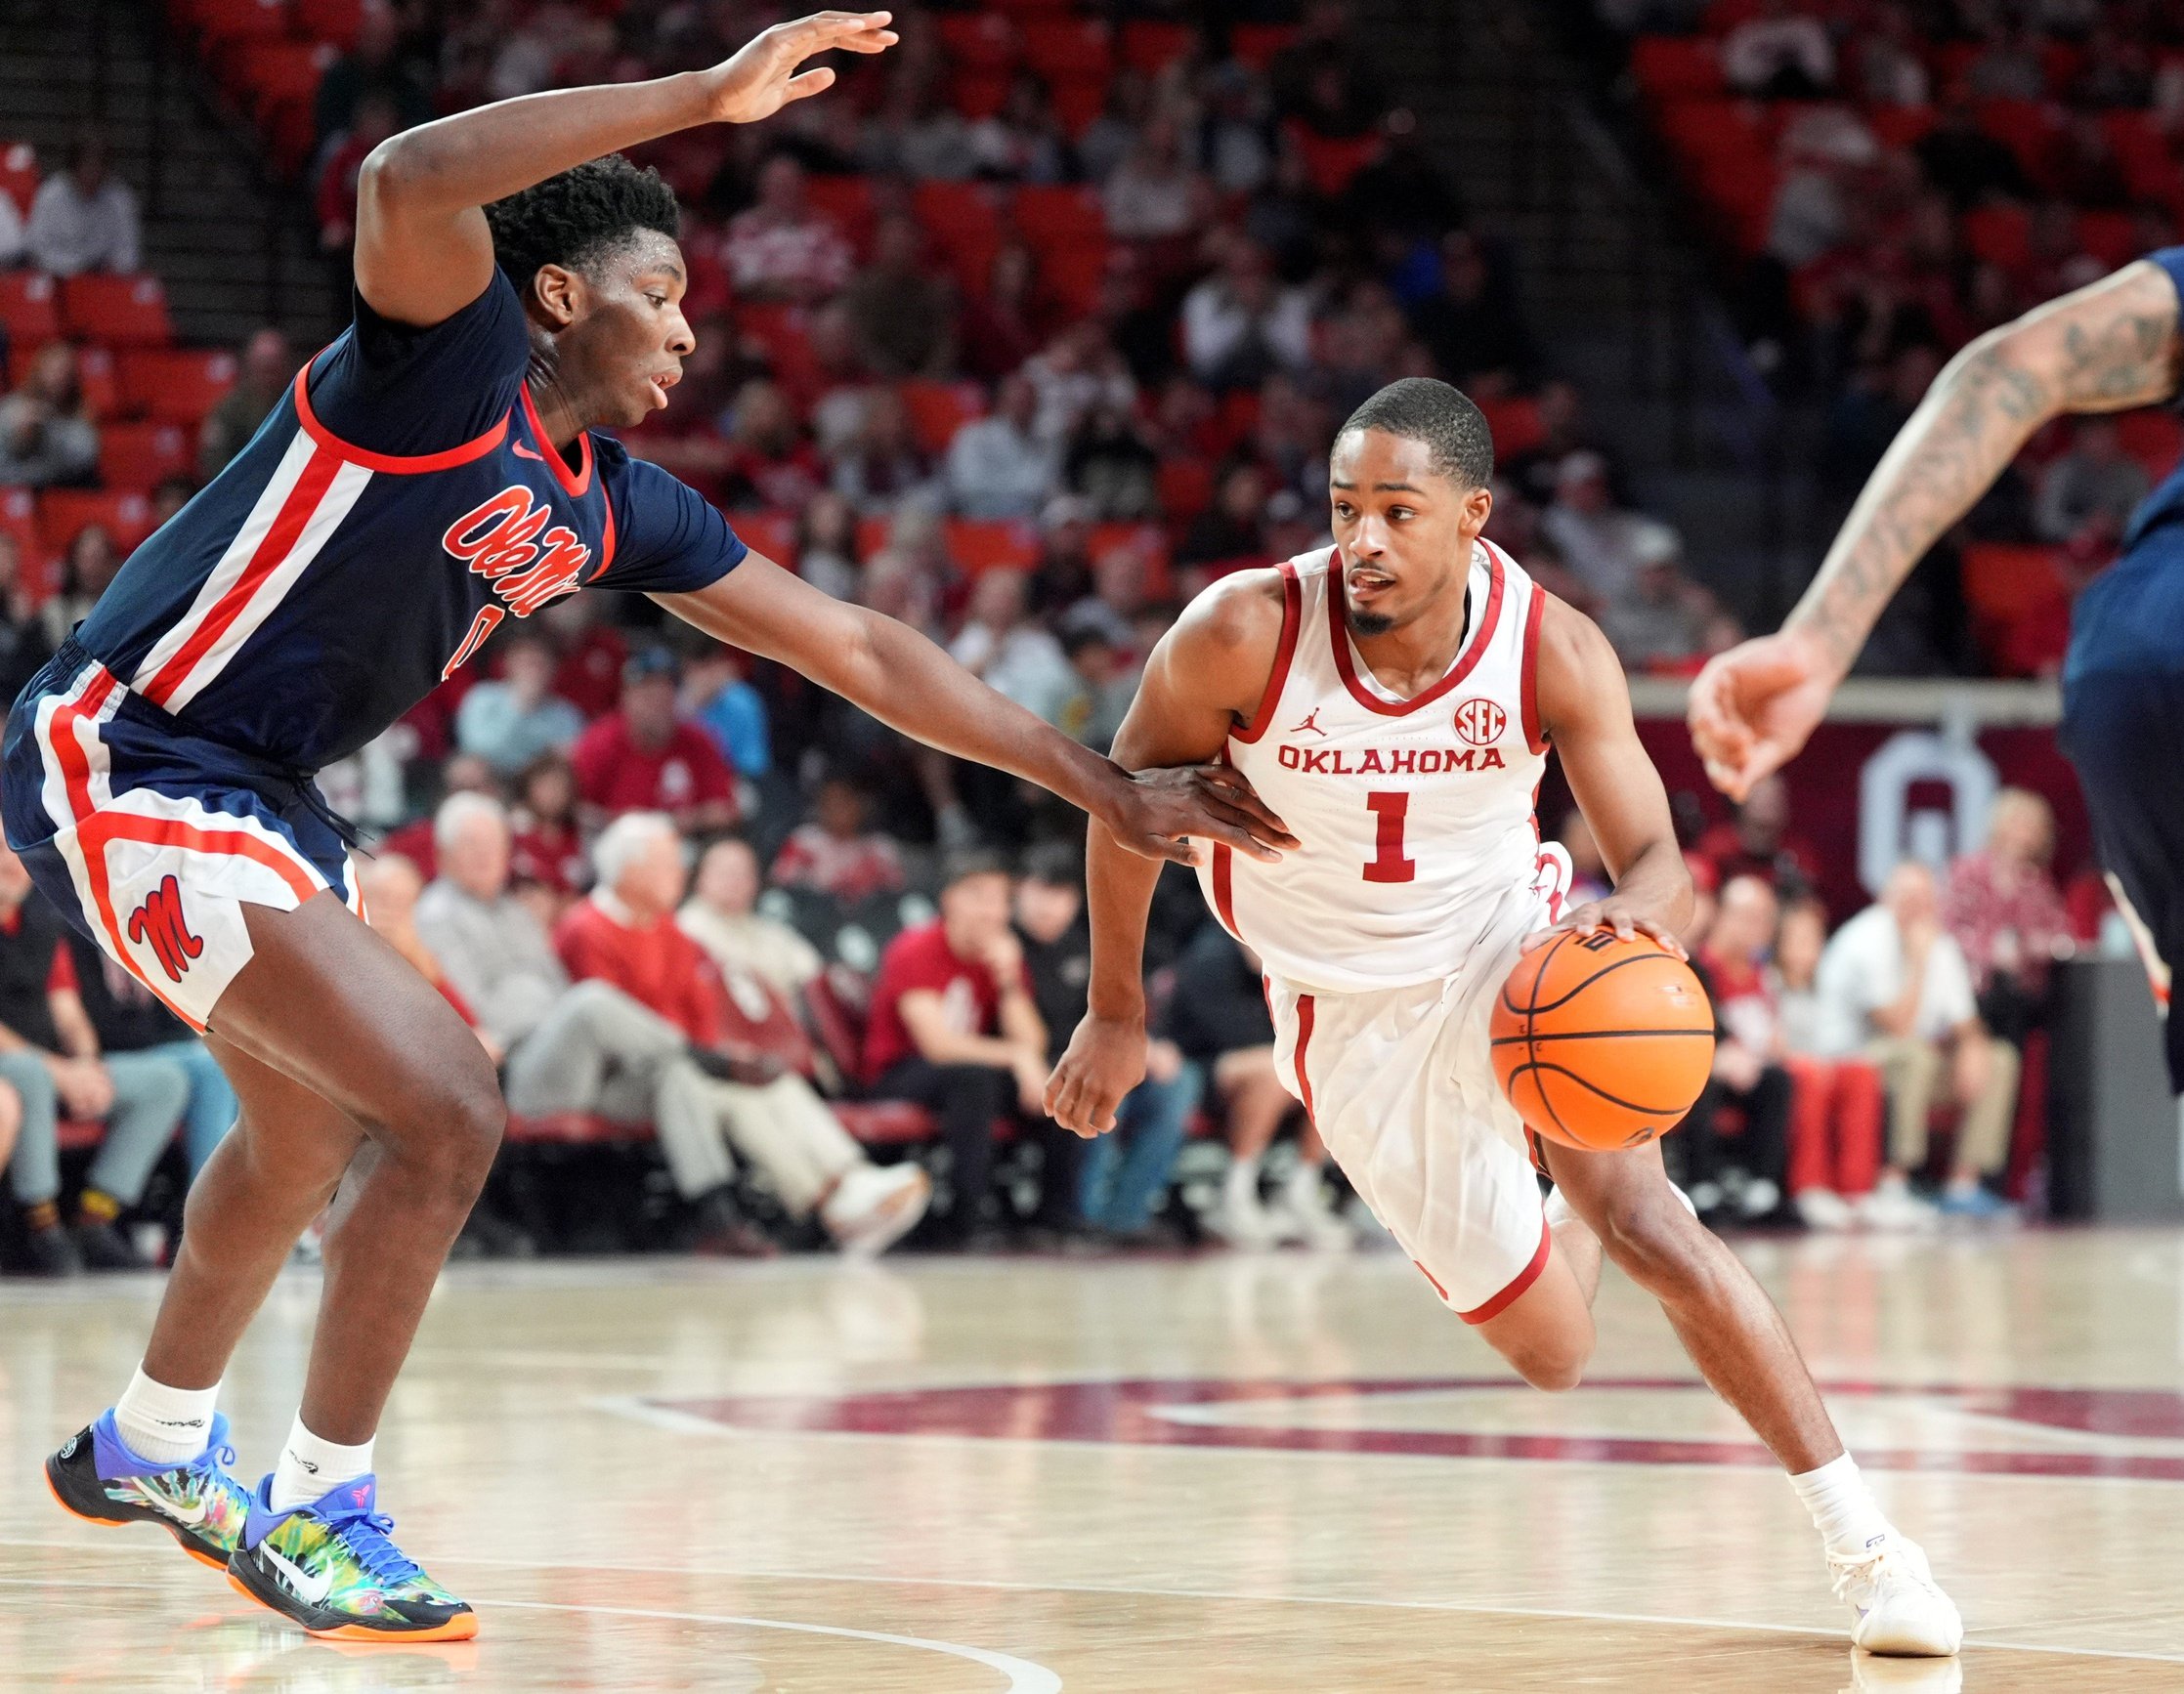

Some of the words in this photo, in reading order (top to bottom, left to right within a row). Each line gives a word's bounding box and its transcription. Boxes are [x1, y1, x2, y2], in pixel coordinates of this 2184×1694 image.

[442, 485, 551, 578] Ole
[1278, 744, 1506, 775] OKLAHOMA
[1458, 700, 1505, 742] SEC
[1362, 791, 1415, 883] 1
[128, 874, 203, 983] M
